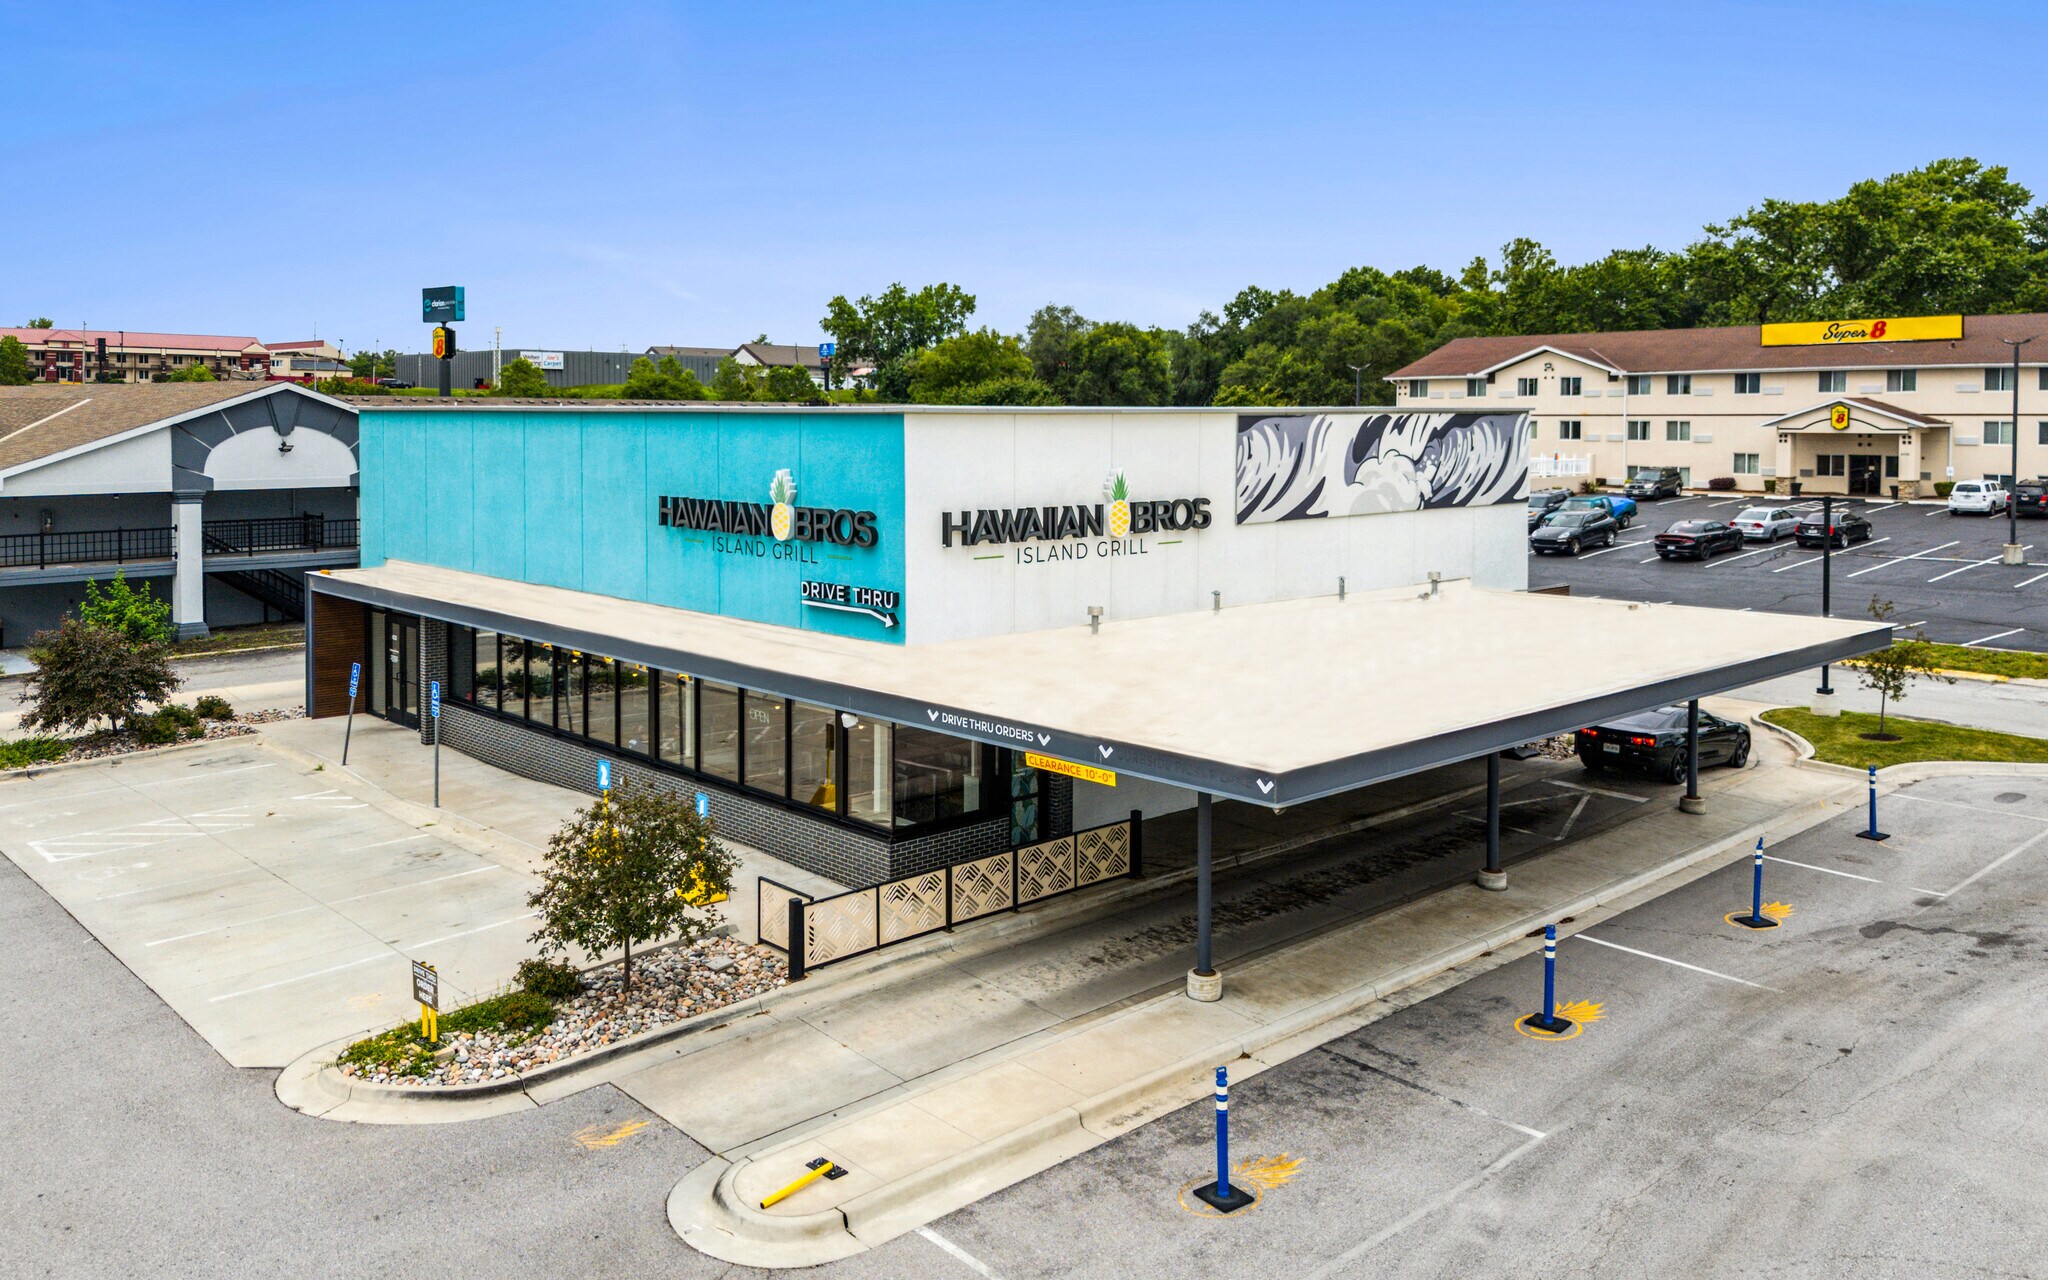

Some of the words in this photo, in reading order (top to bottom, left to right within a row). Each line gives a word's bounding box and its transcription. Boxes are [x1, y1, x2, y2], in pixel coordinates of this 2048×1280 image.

[1822, 323, 1868, 342] Super
[1870, 321, 1887, 339] 8
[1835, 413, 1845, 424] 8
[659, 496, 773, 536] HAWAIIAN
[794, 506, 878, 547] BROS
[942, 504, 1104, 547] HAWAIIAN
[1130, 498, 1212, 533] BROS
[712, 536, 766, 557] ISLAND
[773, 543, 818, 564] GRILL
[1017, 542, 1088, 564] ISLAND
[1097, 538, 1148, 557] GRILL
[801, 581, 847, 602] DRIVE
[852, 585, 897, 608] THRU
[749, 709, 769, 723] OPEN
[941, 712, 968, 728] DRIVE
[969, 719, 994, 733] THRU
[995, 724, 1034, 742] ORDERS
[1028, 755, 1081, 776] CLEARANCE
[416, 978, 434, 994] ORDER
[419, 990, 433, 1005] HERE
